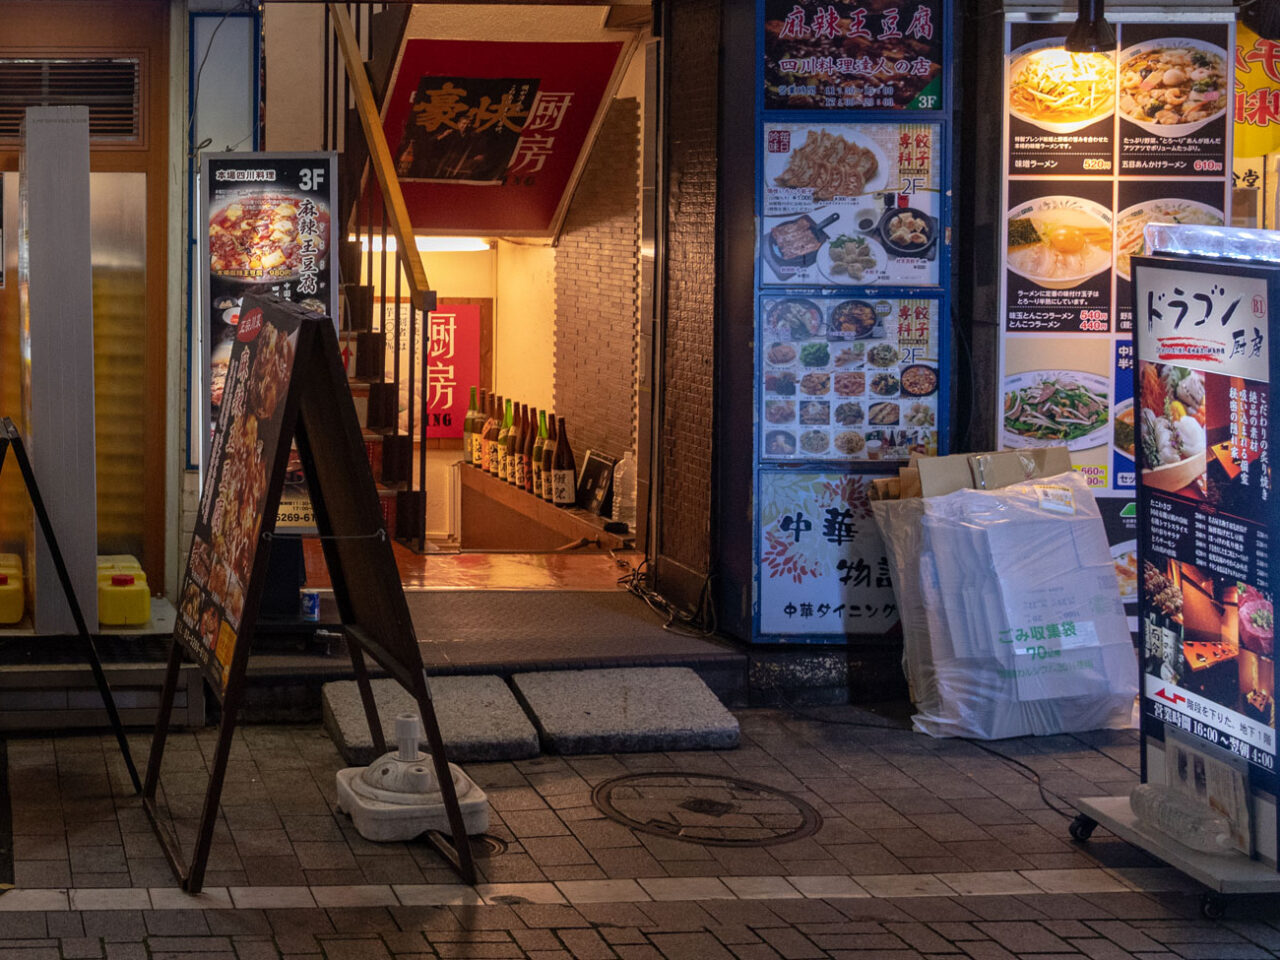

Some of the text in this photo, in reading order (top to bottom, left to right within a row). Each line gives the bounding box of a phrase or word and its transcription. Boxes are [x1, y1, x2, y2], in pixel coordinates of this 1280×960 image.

[779, 5, 934, 40] 麻辣王豆腐
[778, 56, 933, 76] 四川料理達人の店
[918, 95, 937, 109] 3F
[1014, 159, 1059, 168] 味噌ラーメン
[216, 169, 276, 181] 本場四川料理
[298, 168, 324, 191] 3F
[901, 177, 925, 195] 2F
[297, 198, 319, 295] 麻辣王豆腐
[1009, 311, 1075, 321] 味玉とんこつラーメン
[1079, 310, 1109, 321] 540円
[1147, 284, 1244, 333] ドラゴン
[1009, 320, 1061, 329] とんこつラーメン
[1079, 320, 1109, 331] 440円
[427, 313, 458, 410] 厨房
[900, 347, 924, 364] 2F
[780, 507, 859, 546] 中華
[783, 601, 897, 618] 中華ダイニング
[1153, 702, 1192, 732] 営業時間
